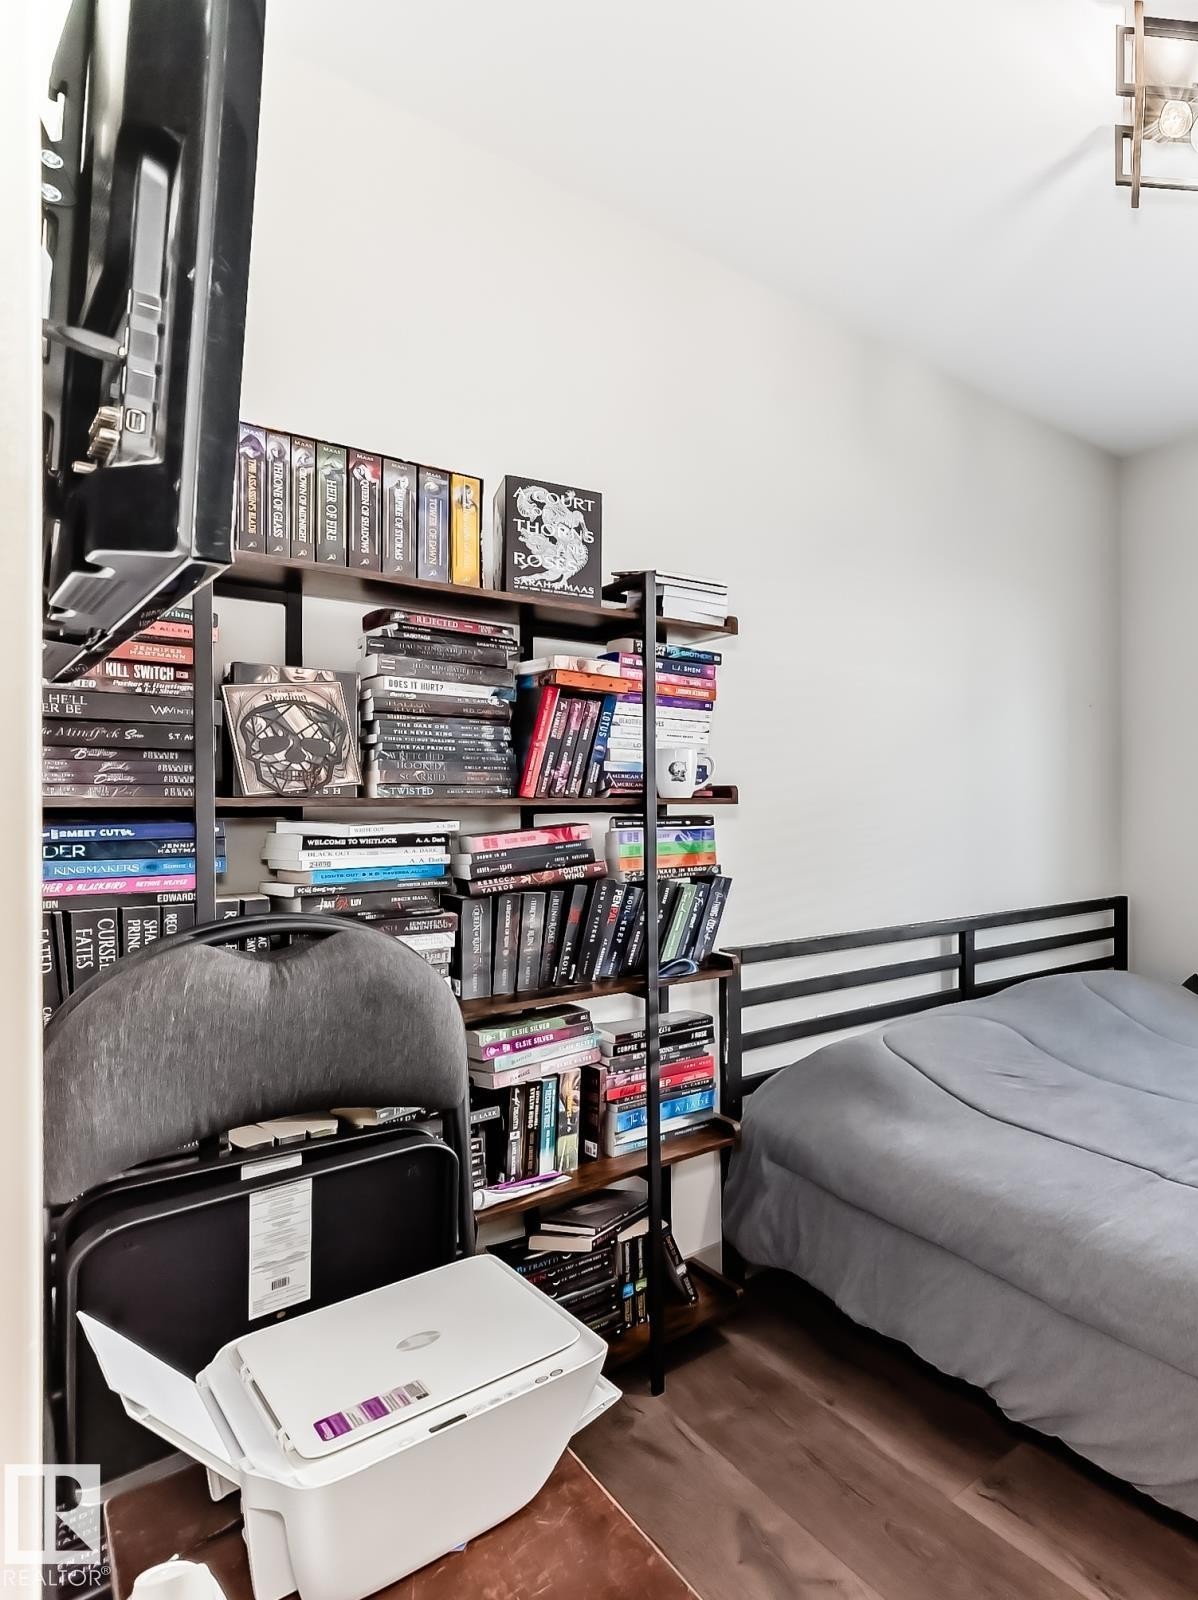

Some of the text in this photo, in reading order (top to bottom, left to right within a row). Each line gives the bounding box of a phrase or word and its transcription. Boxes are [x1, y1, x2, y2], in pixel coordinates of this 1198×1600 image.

[294, 440, 313, 448] MAAS
[513, 487, 596, 512] A COURT
[326, 479, 337, 541] HEIR OF FIRE
[273, 511, 284, 538] GLASS
[360, 517, 370, 554] SHADOWS
[429, 499, 438, 566] TOWER OF DAWN
[513, 518, 595, 544] THORNS
[395, 529, 404, 561] STORMS
[513, 552, 578, 571] ROSES
[513, 577, 595, 595] SARAH MAAS
[416, 615, 459, 629] REJECTED
[159, 627, 190, 635] ALLEN
[403, 633, 431, 641] SABOTAGE
[133, 645, 183, 653] JENNIFER
[129, 650, 187, 661] HARTMANN
[105, 662, 174, 681] KILL SWITCH
[684, 665, 702, 674] SHEN
[388, 679, 445, 692] DOES IT HURT?
[49, 694, 88, 706] HE'LL
[66, 703, 83, 714] BE
[598, 711, 612, 737] LOTUS
[396, 761, 443, 770] HOOKED
[606, 771, 639, 780] AMERICAN
[389, 787, 434, 796] TWISTED
[65, 828, 96, 838] MEET
[307, 838, 347, 846] WELCOME
[359, 837, 398, 845] WHITLOCK
[54, 863, 140, 875] KINGMAKERS
[558, 865, 589, 876] FOURTH
[477, 875, 517, 886] REBECCA
[564, 872, 586, 880] WING
[76, 880, 128, 892] BLACKBIRD
[481, 884, 515, 893] YARROS
[350, 898, 363, 907] LUV
[547, 898, 559, 943] RUIN ROSES
[590, 886, 607, 943] DEN OF VIPERS
[75, 928, 94, 970] FATES
[561, 941, 573, 975] AK ROSE
[511, 1022, 550, 1037] ELSIE SILVER
[515, 1033, 554, 1049] ELSIE SILVER
[617, 1044, 638, 1054] CORPSE
[528, 1087, 536, 1110] EVELYN
[479, 1111, 498, 1120] LARK
